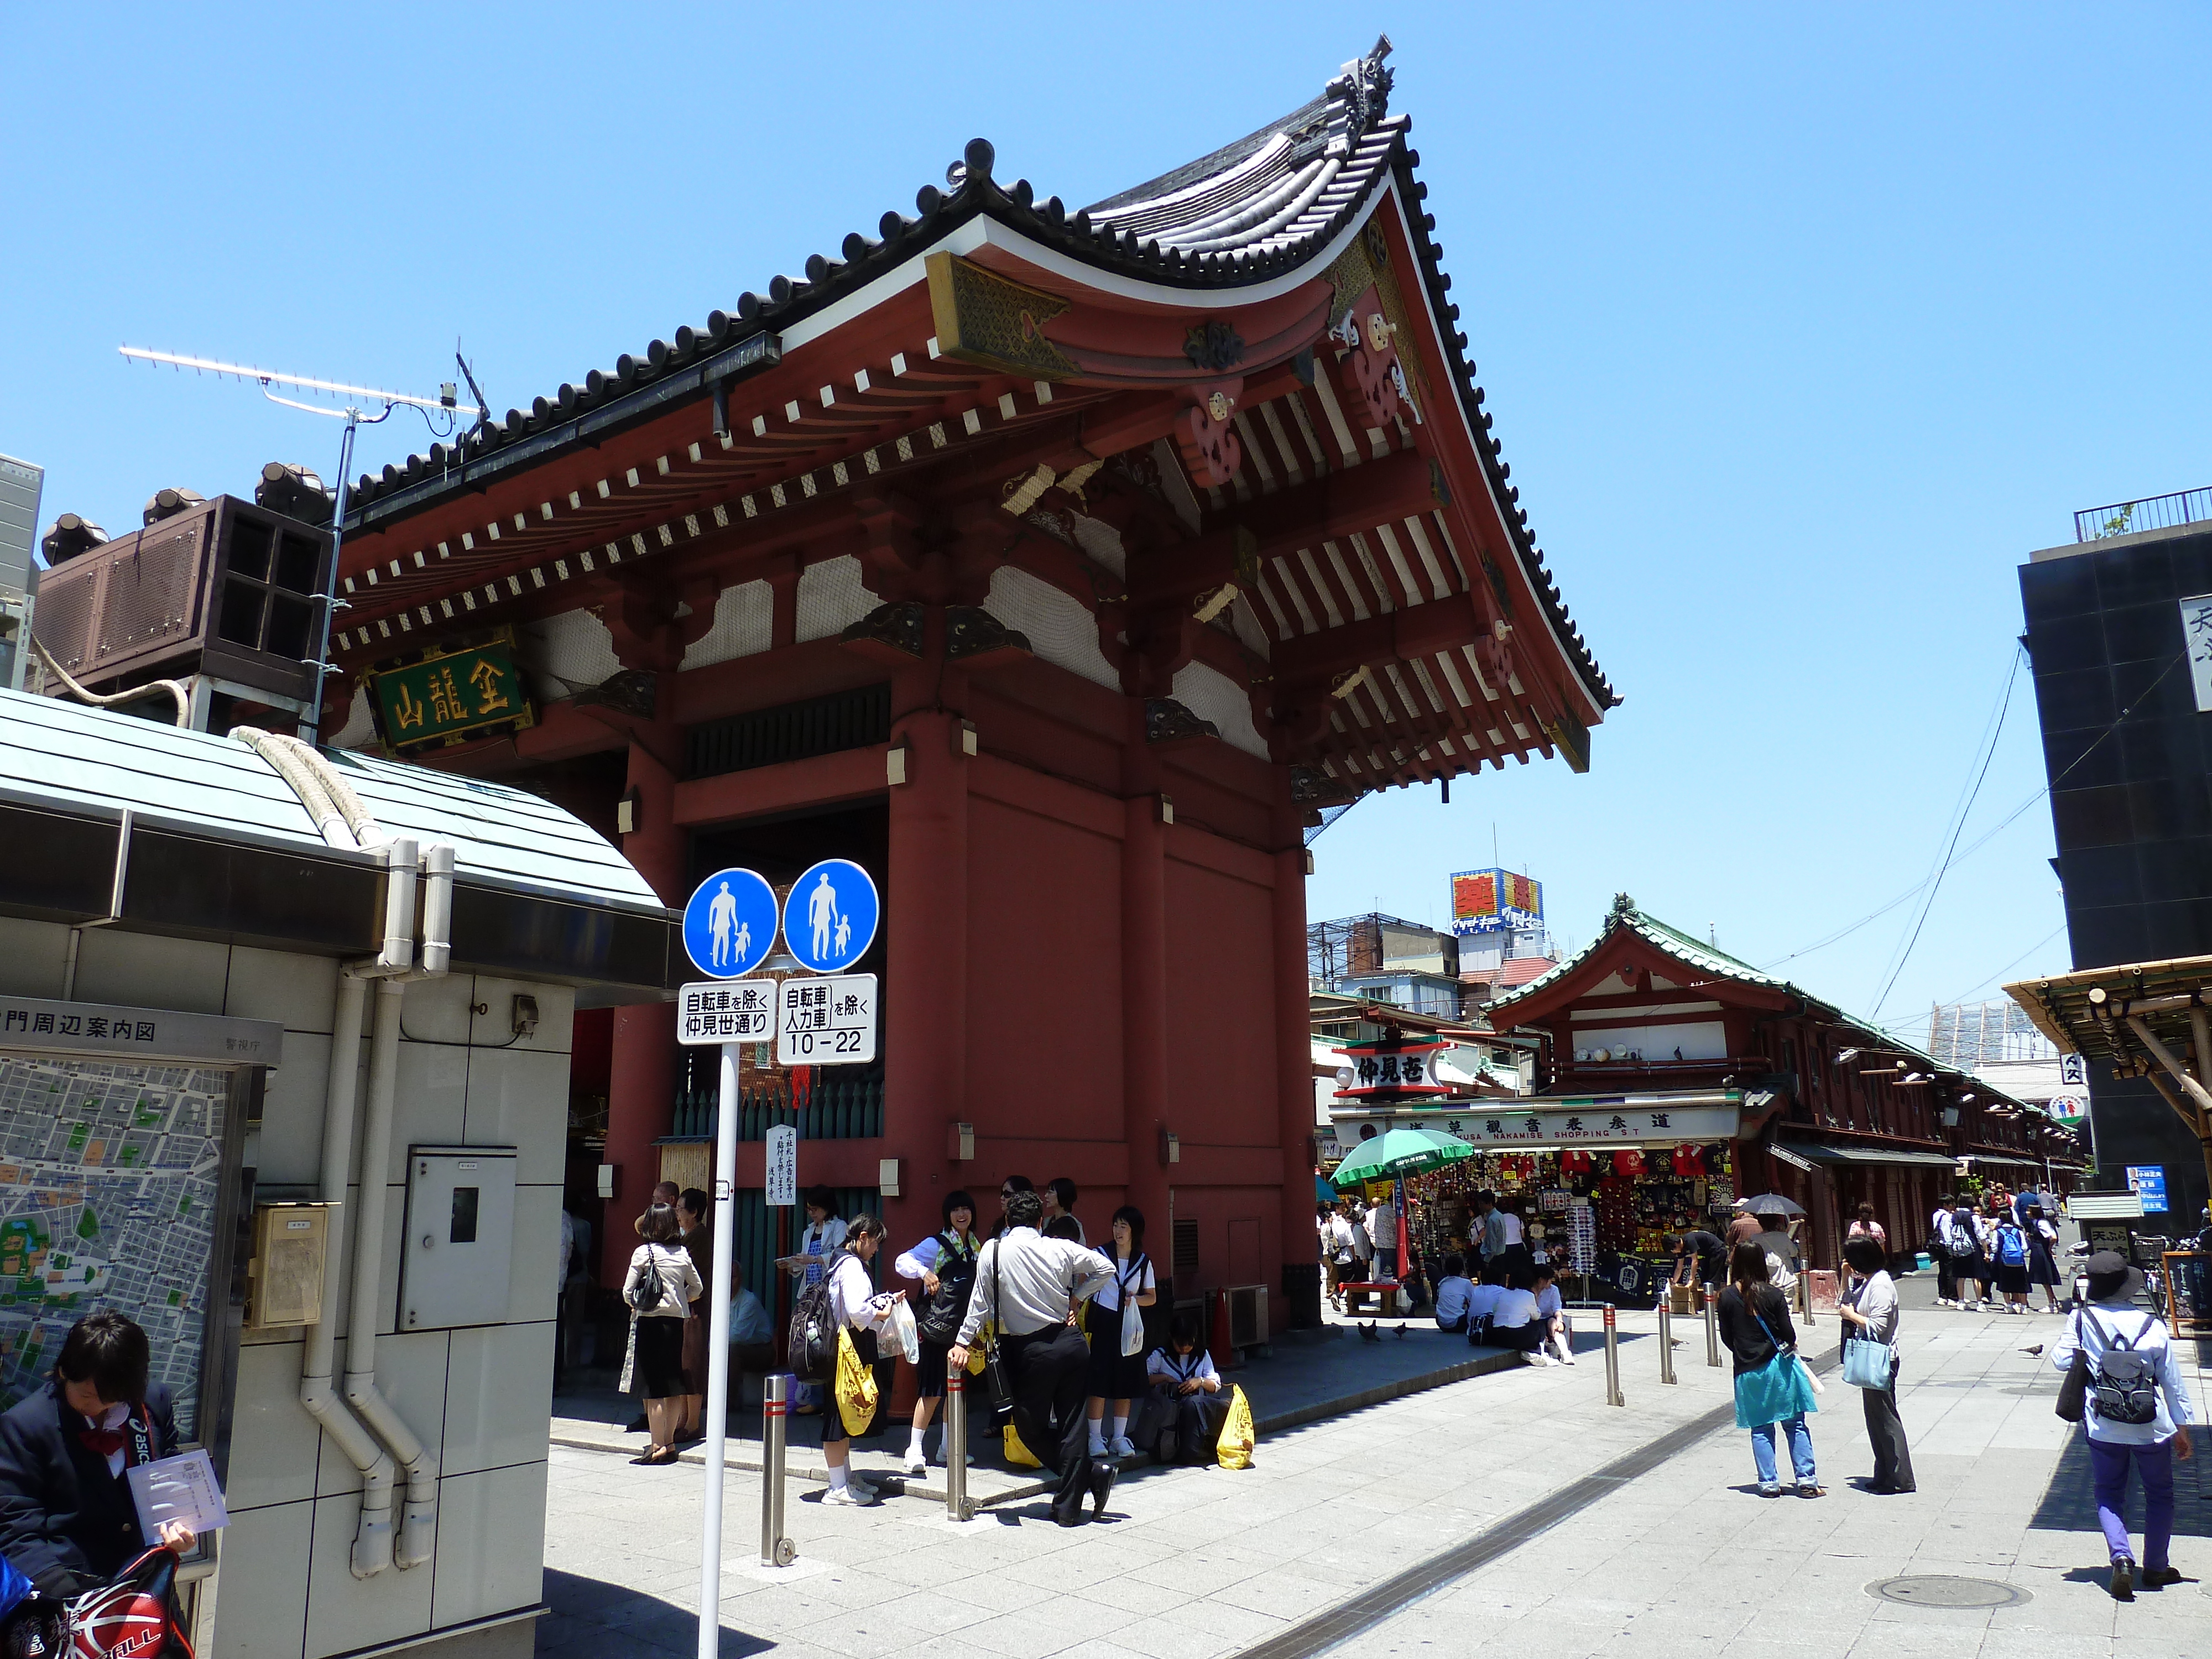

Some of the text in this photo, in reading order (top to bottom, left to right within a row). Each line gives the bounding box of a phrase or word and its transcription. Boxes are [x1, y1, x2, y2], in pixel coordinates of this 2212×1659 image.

[1454, 876, 1495, 914] 薬
[1512, 874, 1531, 910] 薬
[687, 989, 768, 1013] 自転車を除く
[786, 985, 827, 1009] 自転車
[834, 995, 868, 1016] を除く
[0, 1010, 156, 1042] 門周辺案内図
[685, 1013, 767, 1037] 仲見世通り
[785, 1008, 826, 1031] 人力車
[226, 1037, 260, 1051] 警視庁
[1358, 1056, 1423, 1083] 仲見世
[1554, 1130, 1610, 1138] SHOPPING
[2093, 1231, 2126, 1242] 天ぷら
[925, 1317, 953, 1333] NIKE
